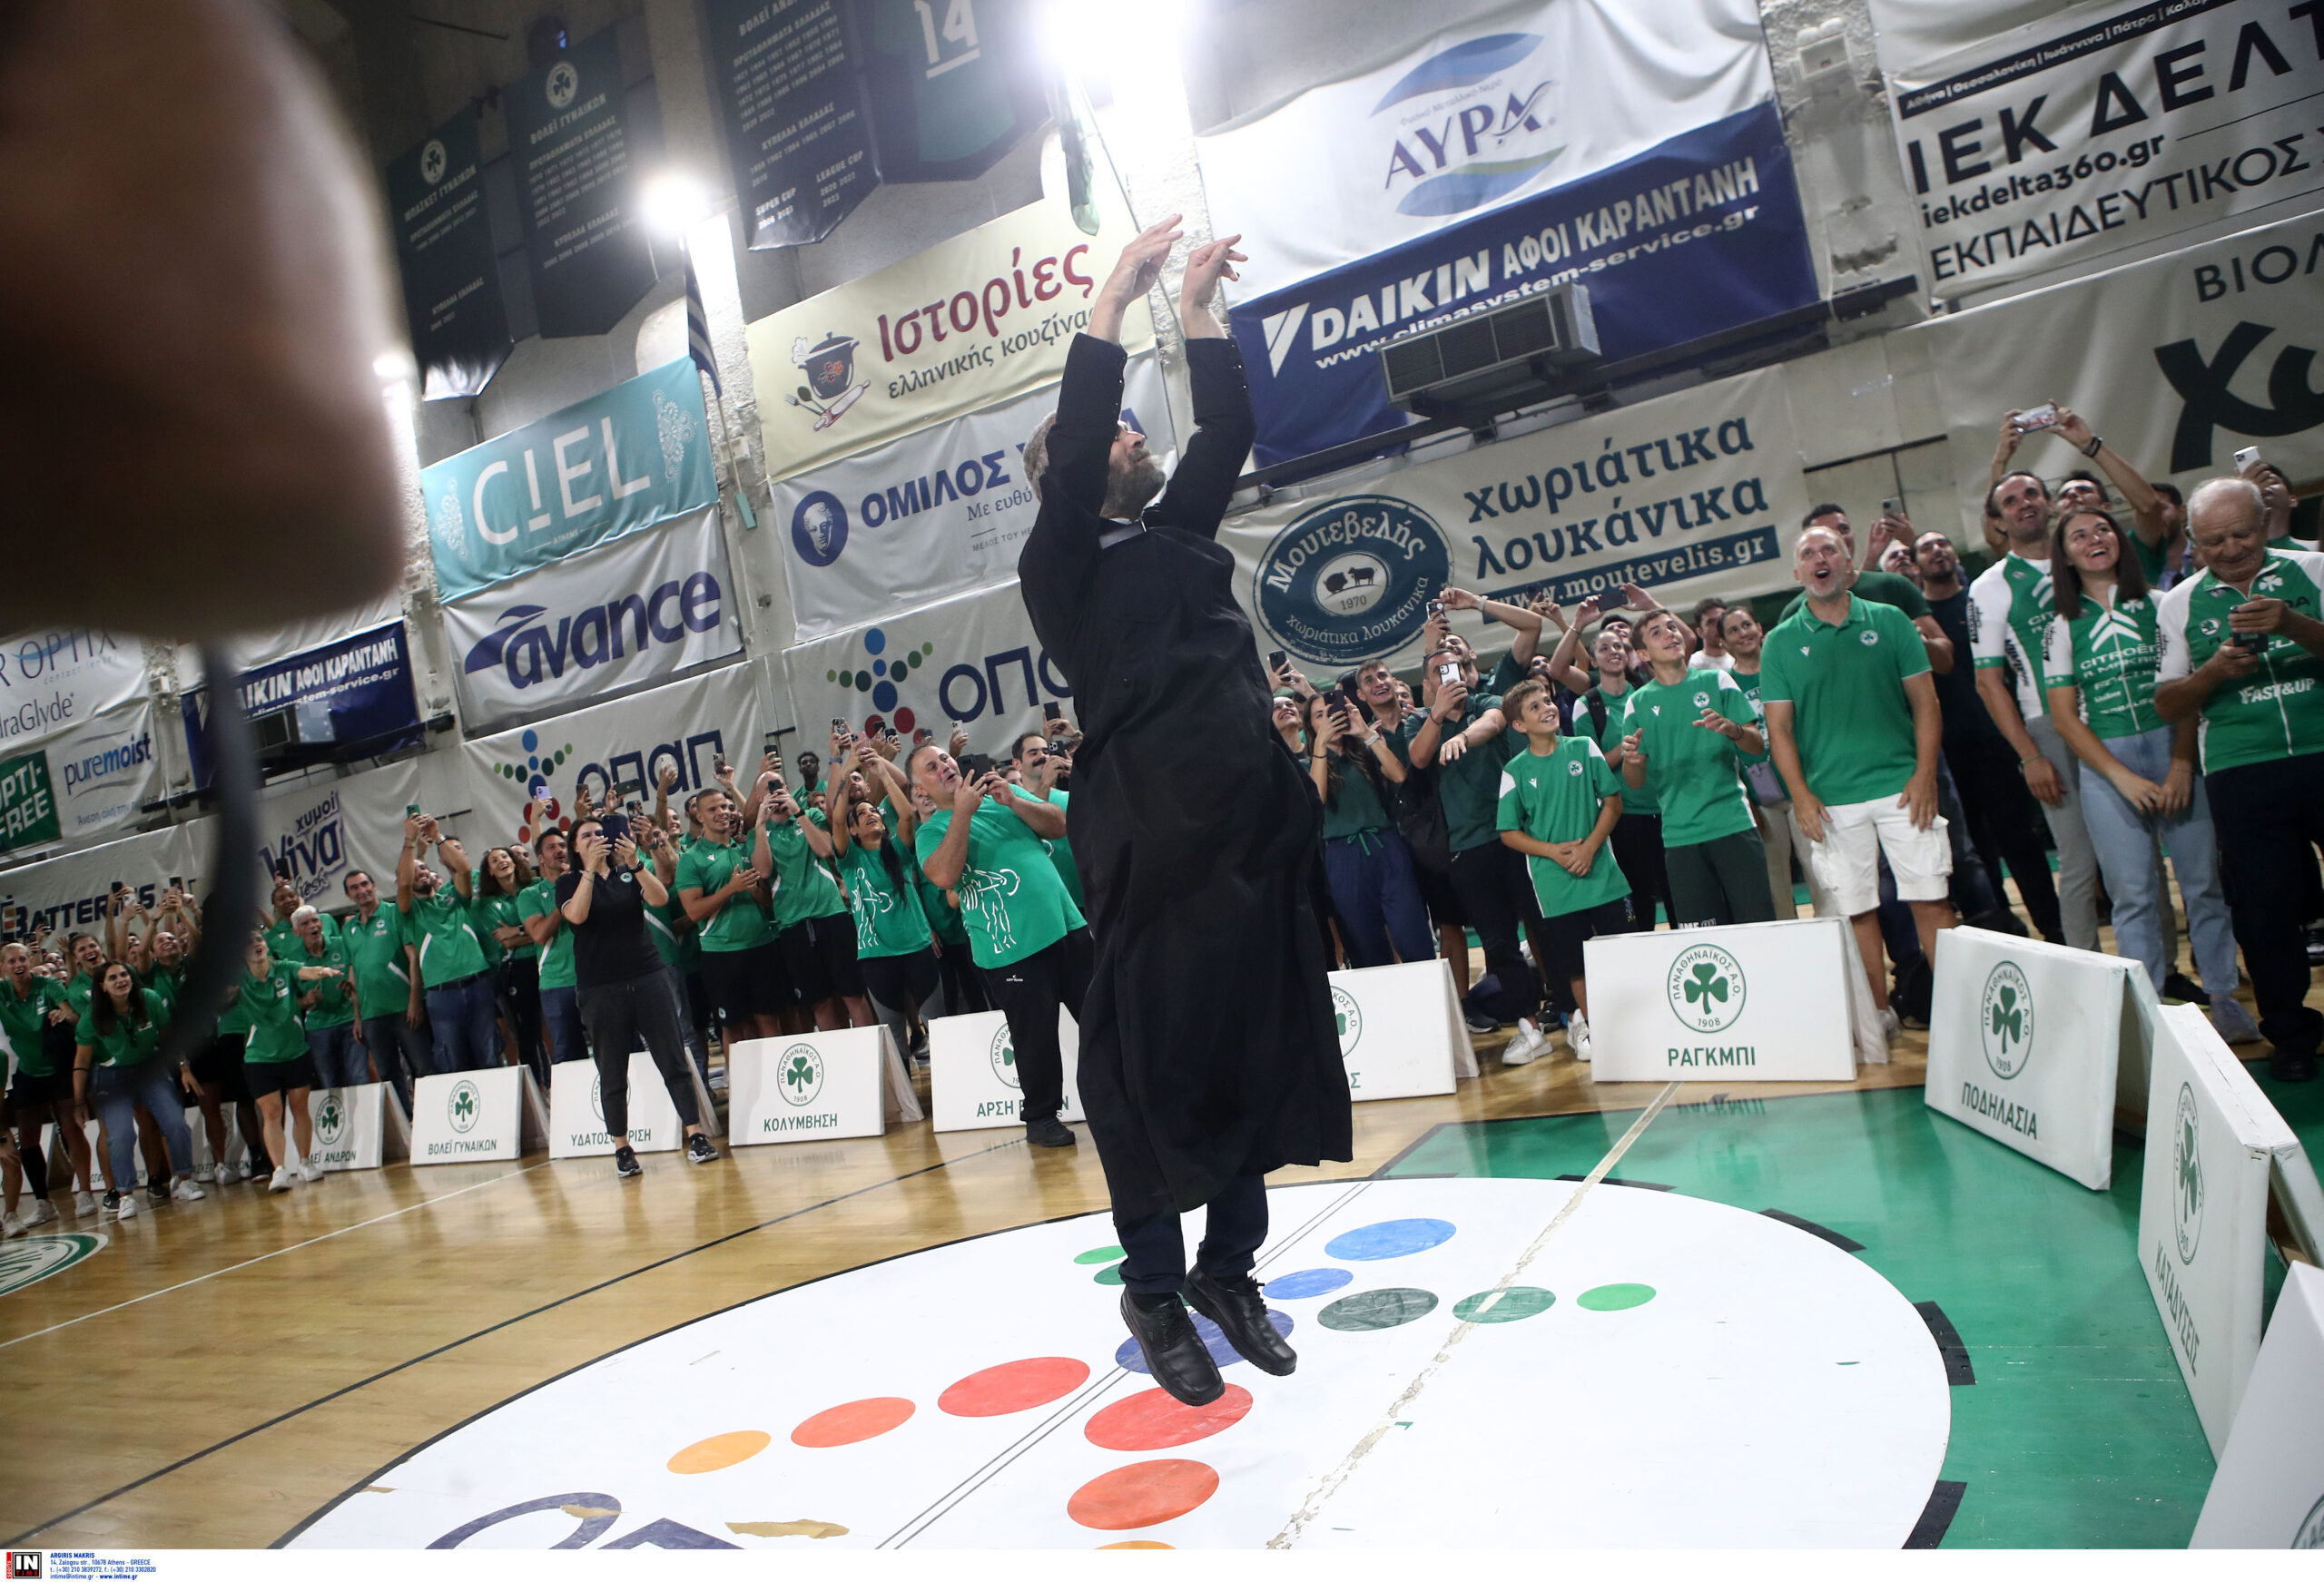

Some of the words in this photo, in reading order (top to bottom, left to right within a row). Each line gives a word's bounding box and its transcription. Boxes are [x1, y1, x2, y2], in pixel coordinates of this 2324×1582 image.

[913, 0, 979, 64] 14
[816, 160, 846, 182] LEAGUE
[847, 150, 863, 165] CUP
[1907, 94, 2058, 194] ΙΕΚ
[755, 196, 781, 217] SUPER
[781, 187, 797, 202] CUP
[1921, 135, 2164, 229] iekdelta360.gr
[1931, 133, 2310, 281] ΕΚΠΑΙΔΕΥΤΙΚΟΣ
[1312, 250, 1490, 351] DAIKIN
[1502, 223, 1570, 280] ΑΦΟΙ
[1578, 157, 1759, 254] ΚΑΡΑΝΤΑΝΗ
[877, 243, 1094, 362] Ιστορίες
[888, 344, 994, 398] ελληνικής
[473, 416, 651, 545] CIEL
[861, 450, 1010, 528] ΟΜΙΛΟΣ
[1463, 418, 1754, 523] χωριάτικα
[966, 502, 990, 522] Με
[1472, 477, 1768, 580] λουκάνικα
[1266, 510, 1427, 594] Μουτεβελής
[506, 571, 721, 689] avance
[1340, 594, 1367, 611] 1970
[1362, 576, 1430, 642] λουκάνικα
[295, 662, 326, 693] ΑΦΟΙ
[325, 637, 399, 682] ΚΑΡΑΝΤΑΝΗ
[0, 692, 73, 739] raGlyde
[0, 761, 42, 811] PTI-
[64, 732, 152, 796] puremoist
[1673, 948, 1734, 1000] ΠΑΝΑΘΗΝΑΪΚΟΣ
[1697, 1017, 1721, 1027] 1908
[1668, 1046, 1756, 1066] ΡΑΓΚΜΠΙ
[763, 1113, 838, 1132] ΚΟΛΥΜΒΗΣΗ
[976, 1099, 1014, 1117] ΑΡΣΗ
[1961, 1082, 2037, 1140] ΠΟΔΗΛΑΣΙΑ
[324, 1150, 356, 1163] ΑΝΔΡΩΝ
[428, 1139, 453, 1155] ΒΟΛΕΪ
[454, 1138, 497, 1155] ΓΥΝΑΙΚΩΝ
[571, 1128, 652, 1146] ΥΔΑΤΟΣΡΙΣΗ
